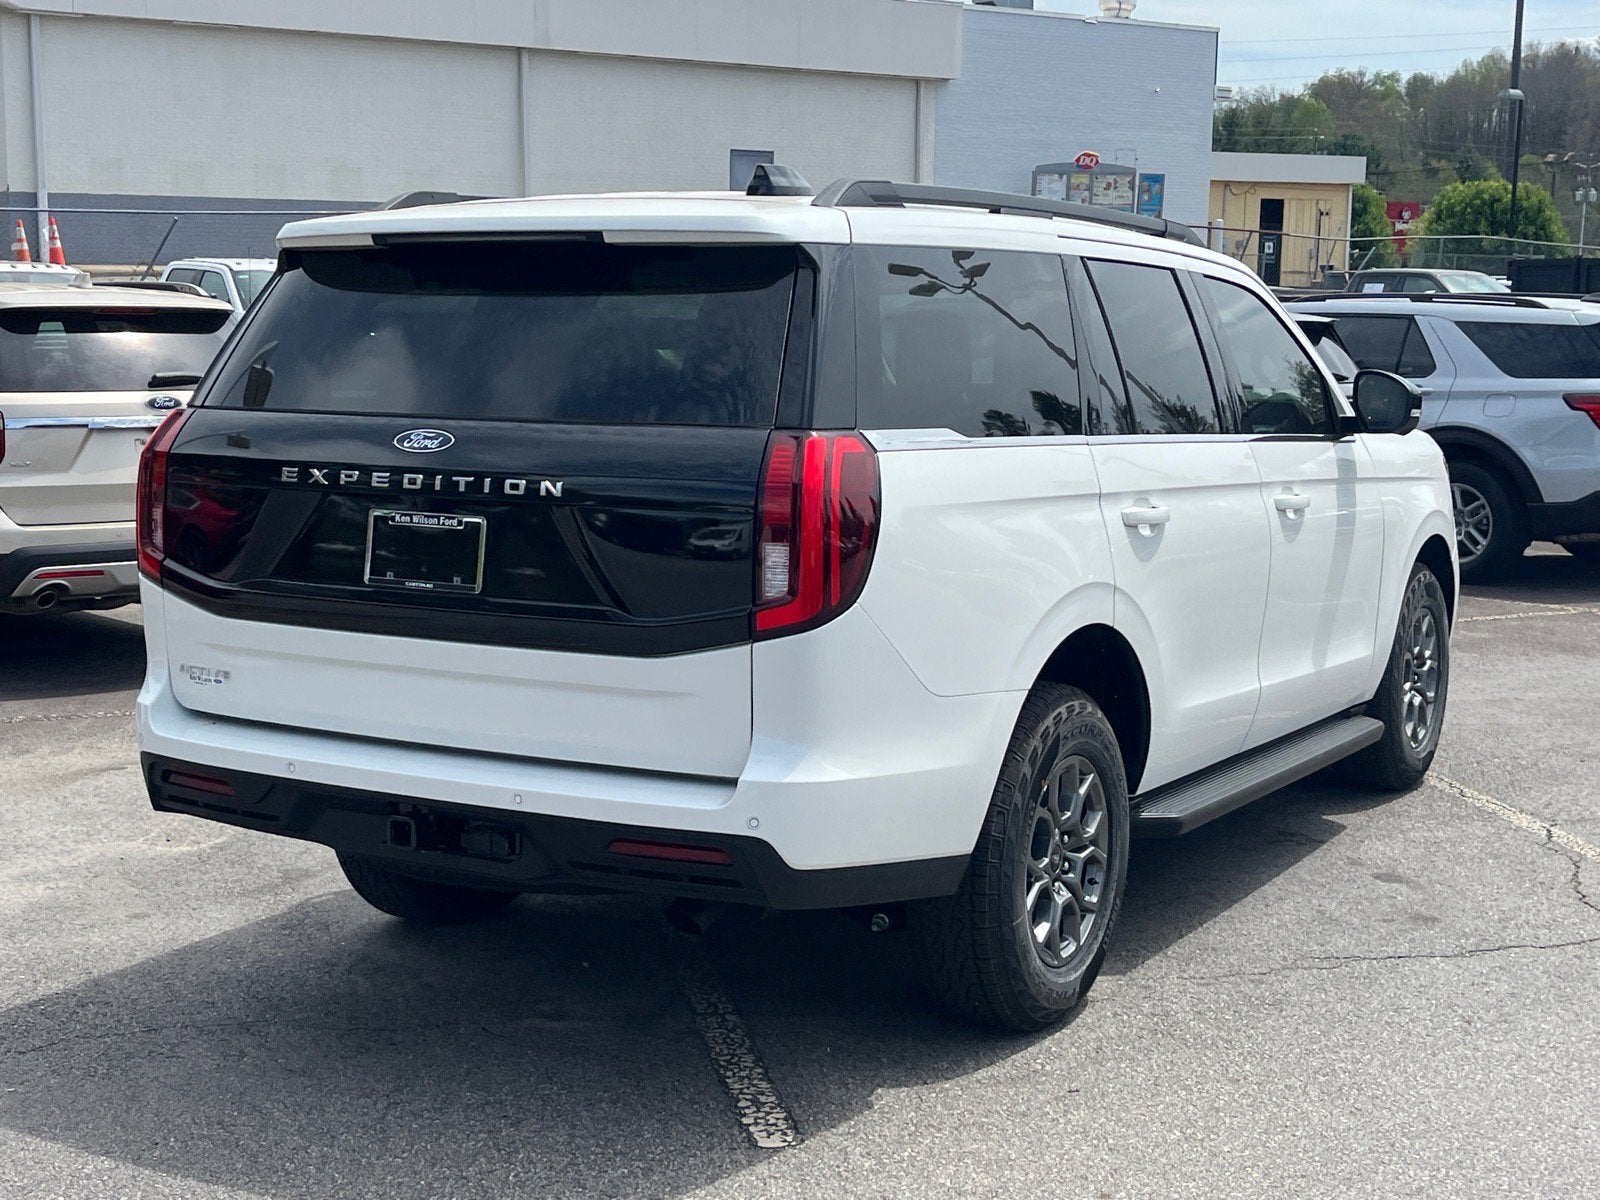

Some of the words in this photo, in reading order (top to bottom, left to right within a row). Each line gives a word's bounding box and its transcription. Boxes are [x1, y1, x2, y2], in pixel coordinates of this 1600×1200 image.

[1079, 155, 1096, 167] DQ
[403, 431, 443, 448] Ford
[281, 466, 563, 497] EXPEDITION
[395, 513, 410, 523] Ken
[412, 515, 438, 525] Wilson
[440, 516, 457, 526] Ford
